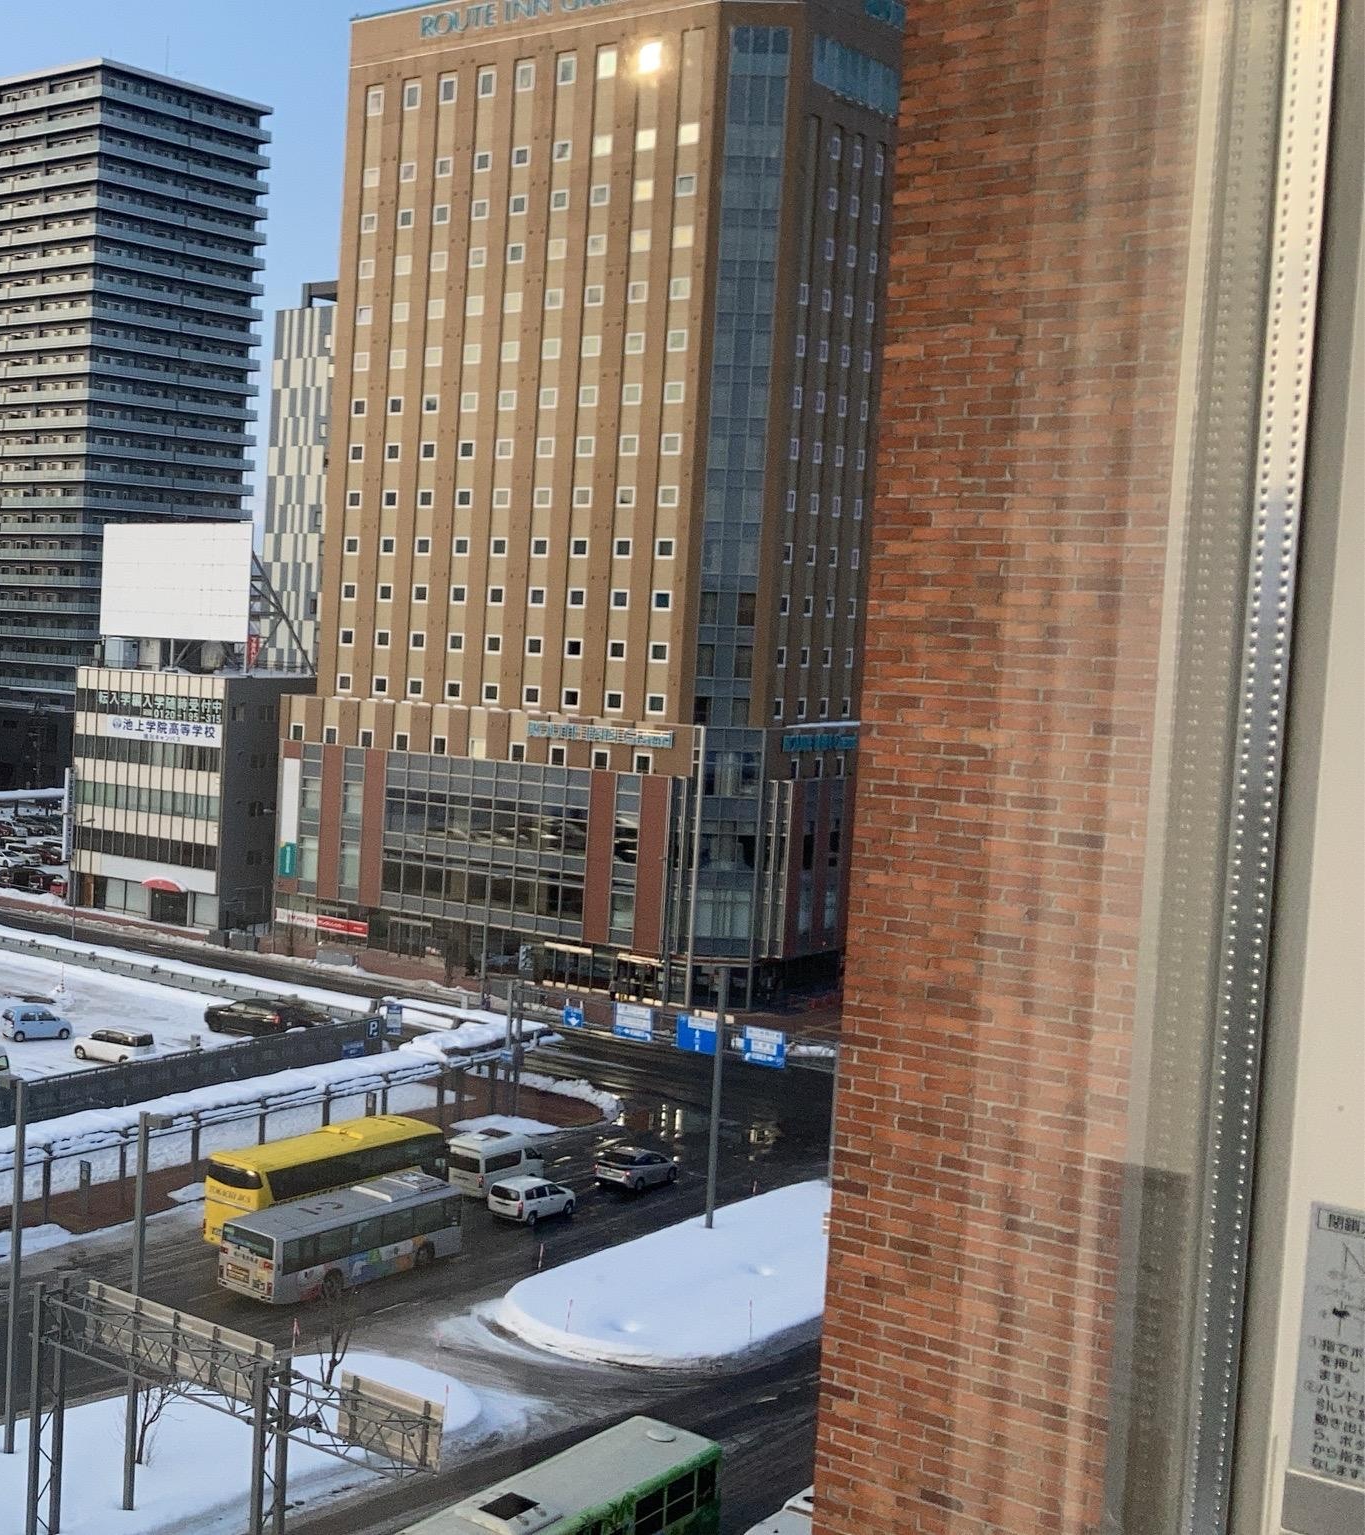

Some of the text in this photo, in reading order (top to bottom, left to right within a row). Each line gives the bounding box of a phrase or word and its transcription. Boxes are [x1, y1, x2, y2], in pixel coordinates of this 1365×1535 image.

[420, 3, 497, 39] ROUTE
[503, 0, 553, 24] INN
[153, 708, 222, 724] 0120-195-315
[122, 718, 216, 739] 池上学院高等学校
[1328, 1213, 1365, 1239] 閉鎖
